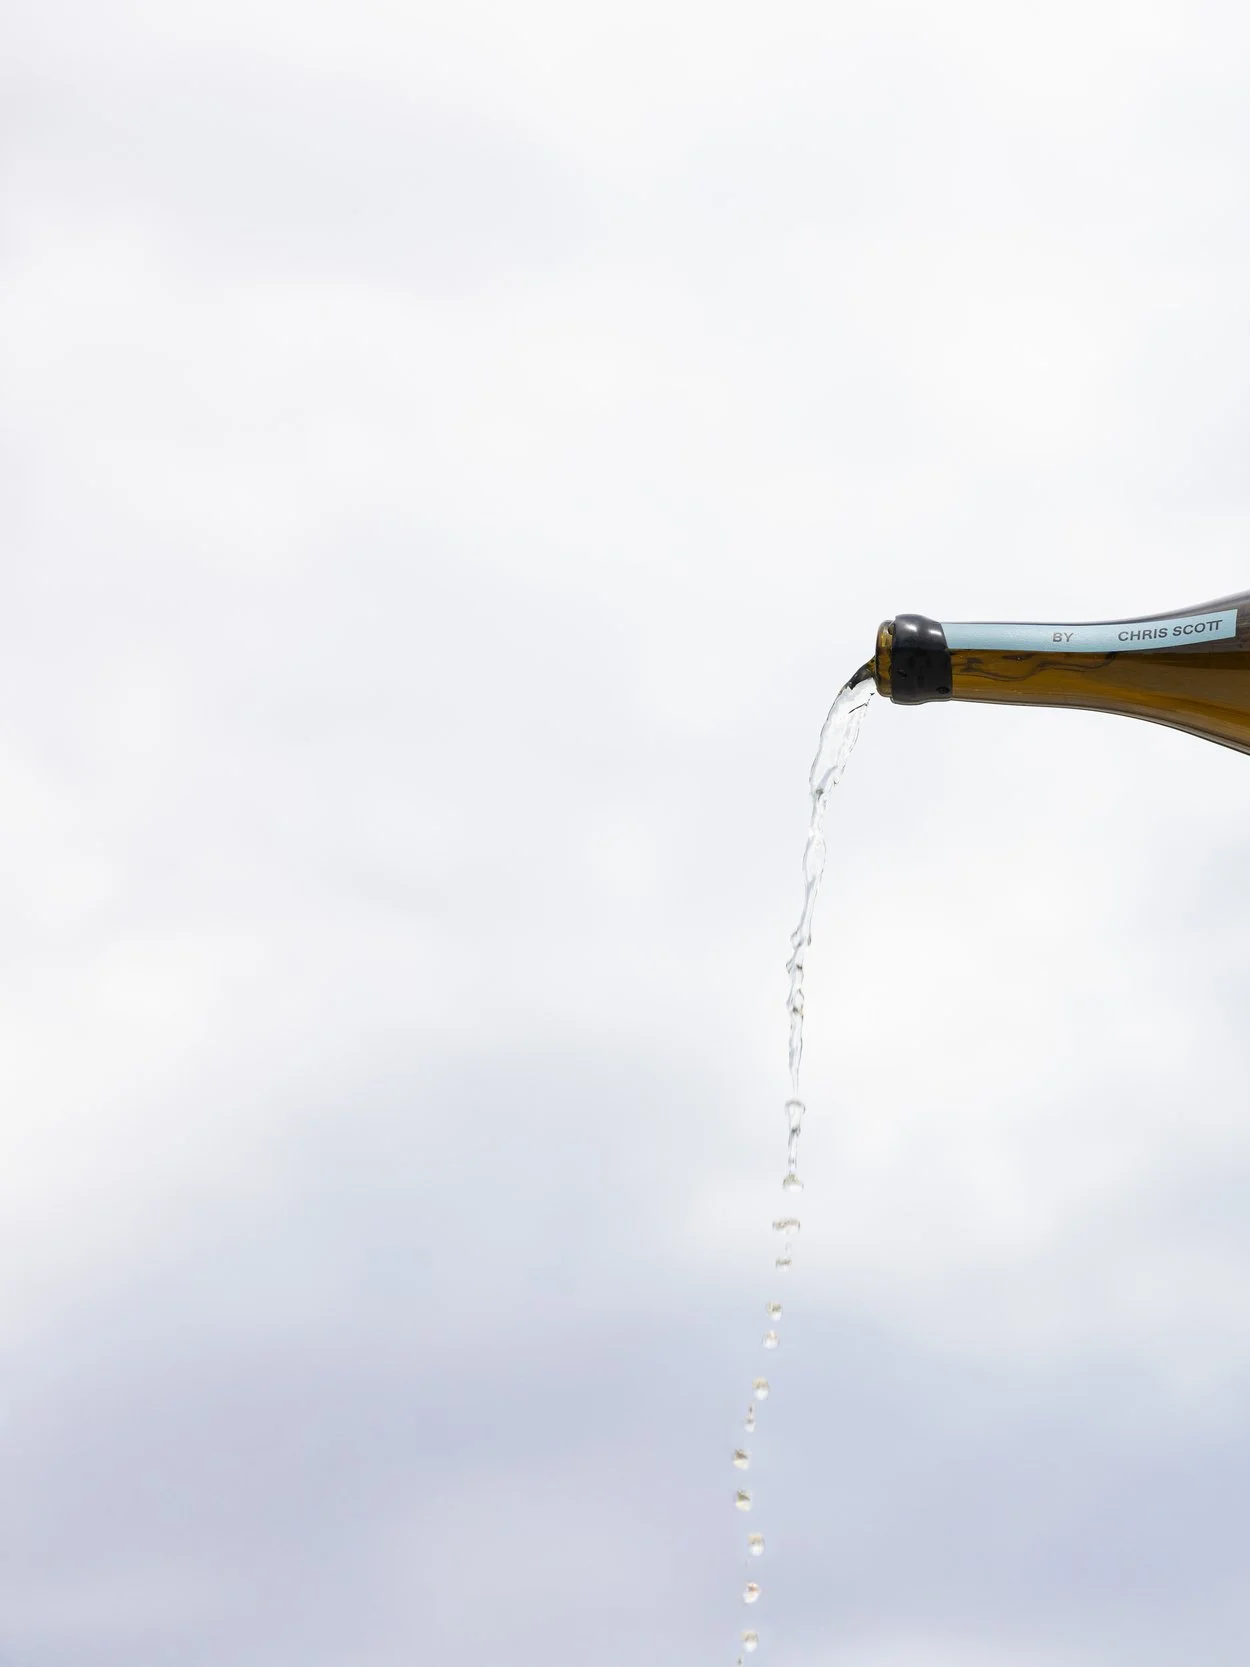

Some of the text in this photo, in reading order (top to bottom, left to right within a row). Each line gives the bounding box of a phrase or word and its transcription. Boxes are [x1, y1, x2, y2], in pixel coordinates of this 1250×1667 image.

[1052, 619, 1223, 643] BY CHRIS SCOTT
